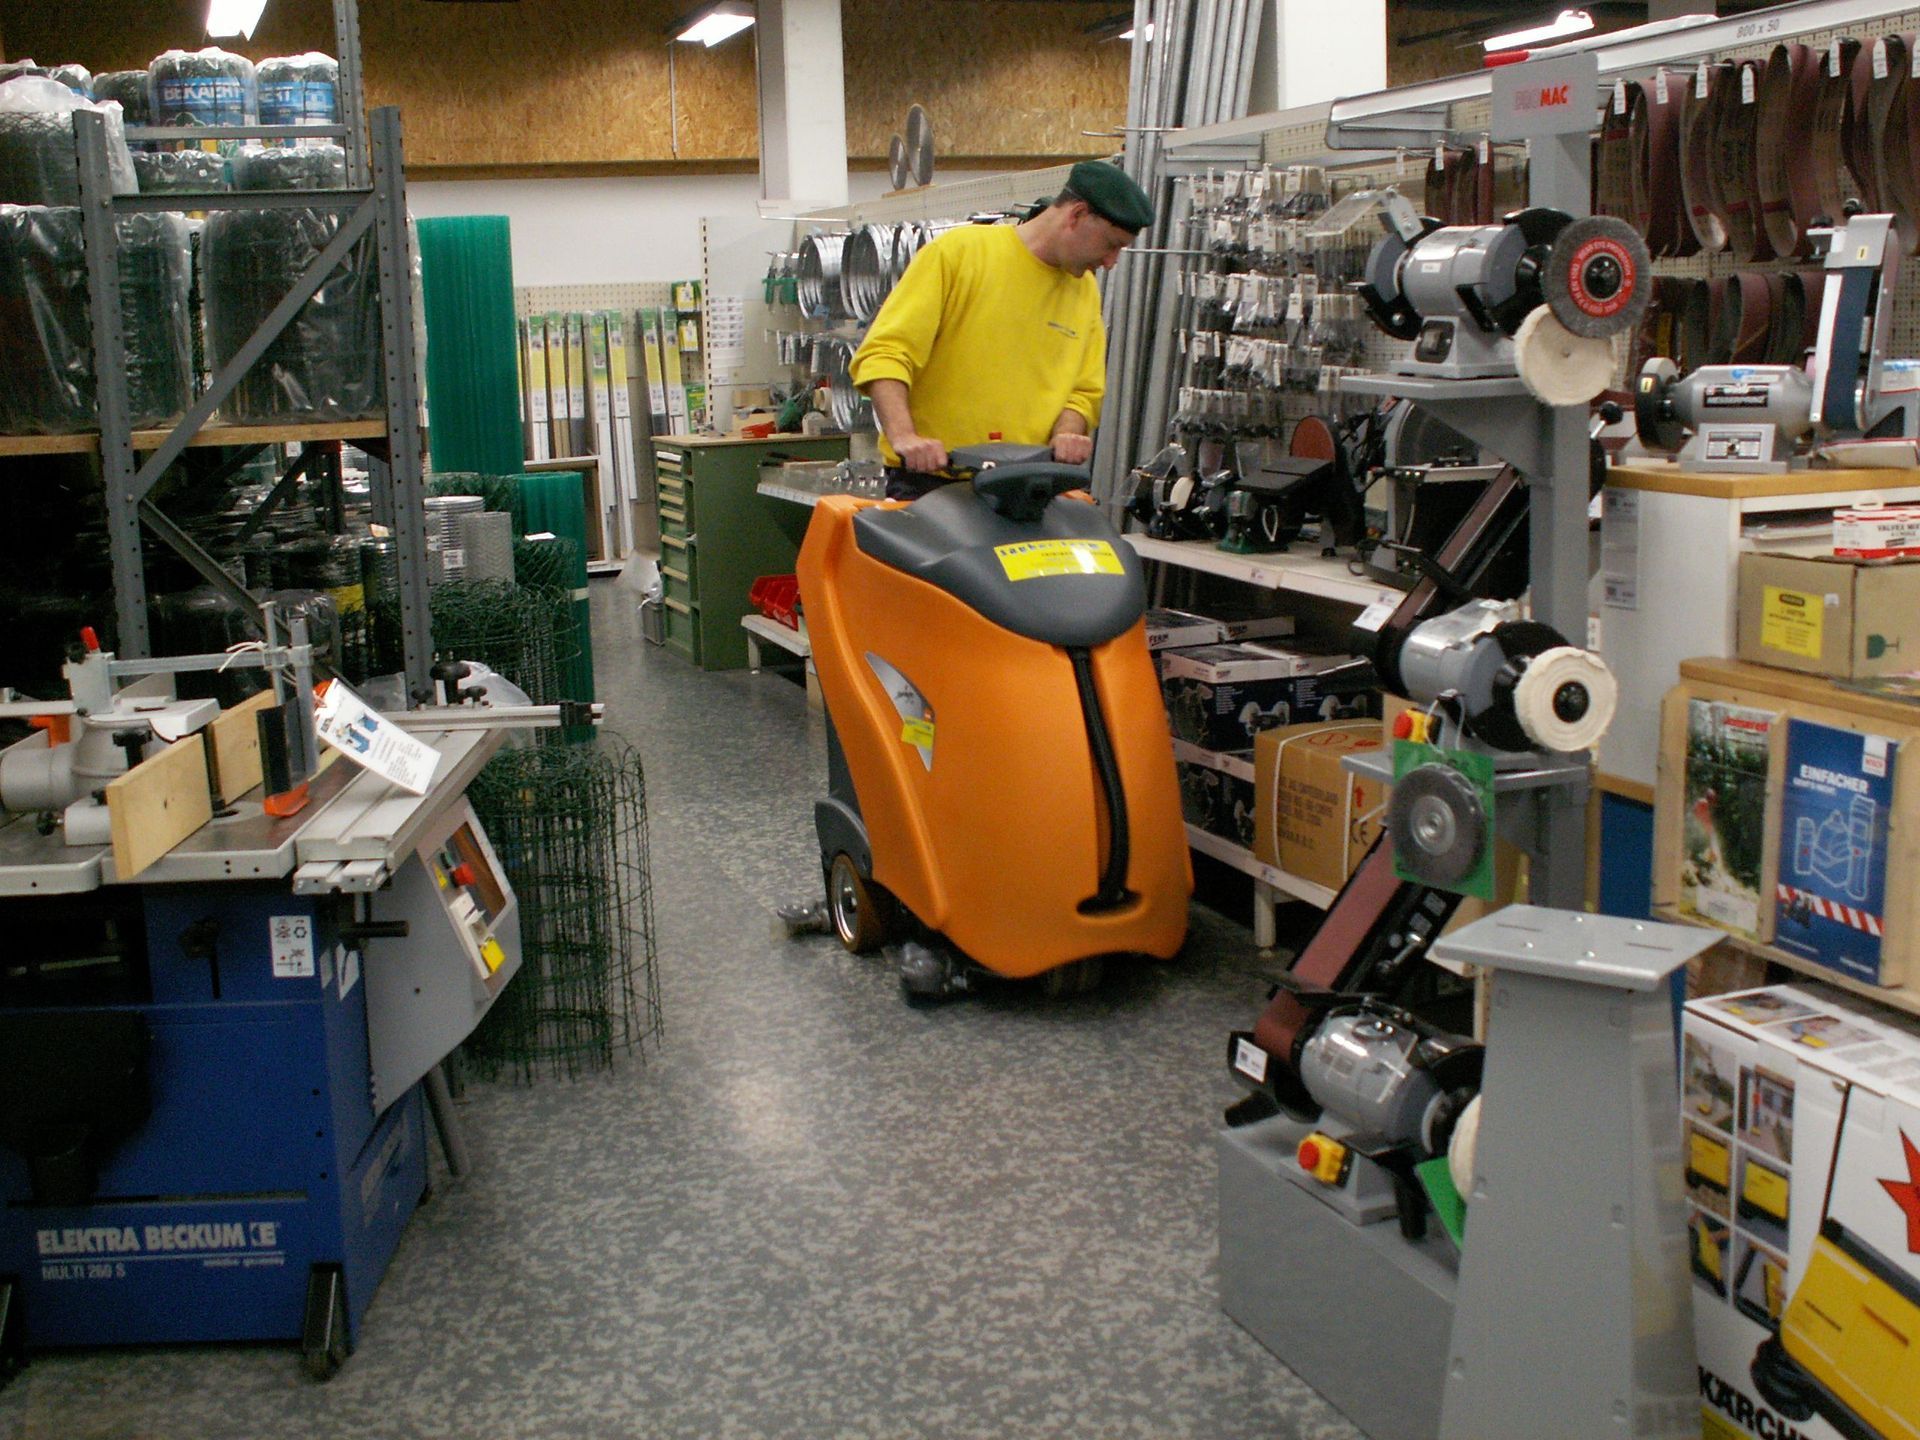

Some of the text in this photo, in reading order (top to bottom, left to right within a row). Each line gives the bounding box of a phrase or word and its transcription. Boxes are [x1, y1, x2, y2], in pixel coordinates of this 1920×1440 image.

[1767, 18, 1780, 32] 50
[1148, 633, 1170, 646] FERM
[1800, 764, 1868, 795] EINFACHER
[37, 1226, 141, 1255] ELEKTRA
[144, 1222, 247, 1250] BECKUM
[41, 1264, 85, 1281] MULTI
[115, 1262, 126, 1278] S
